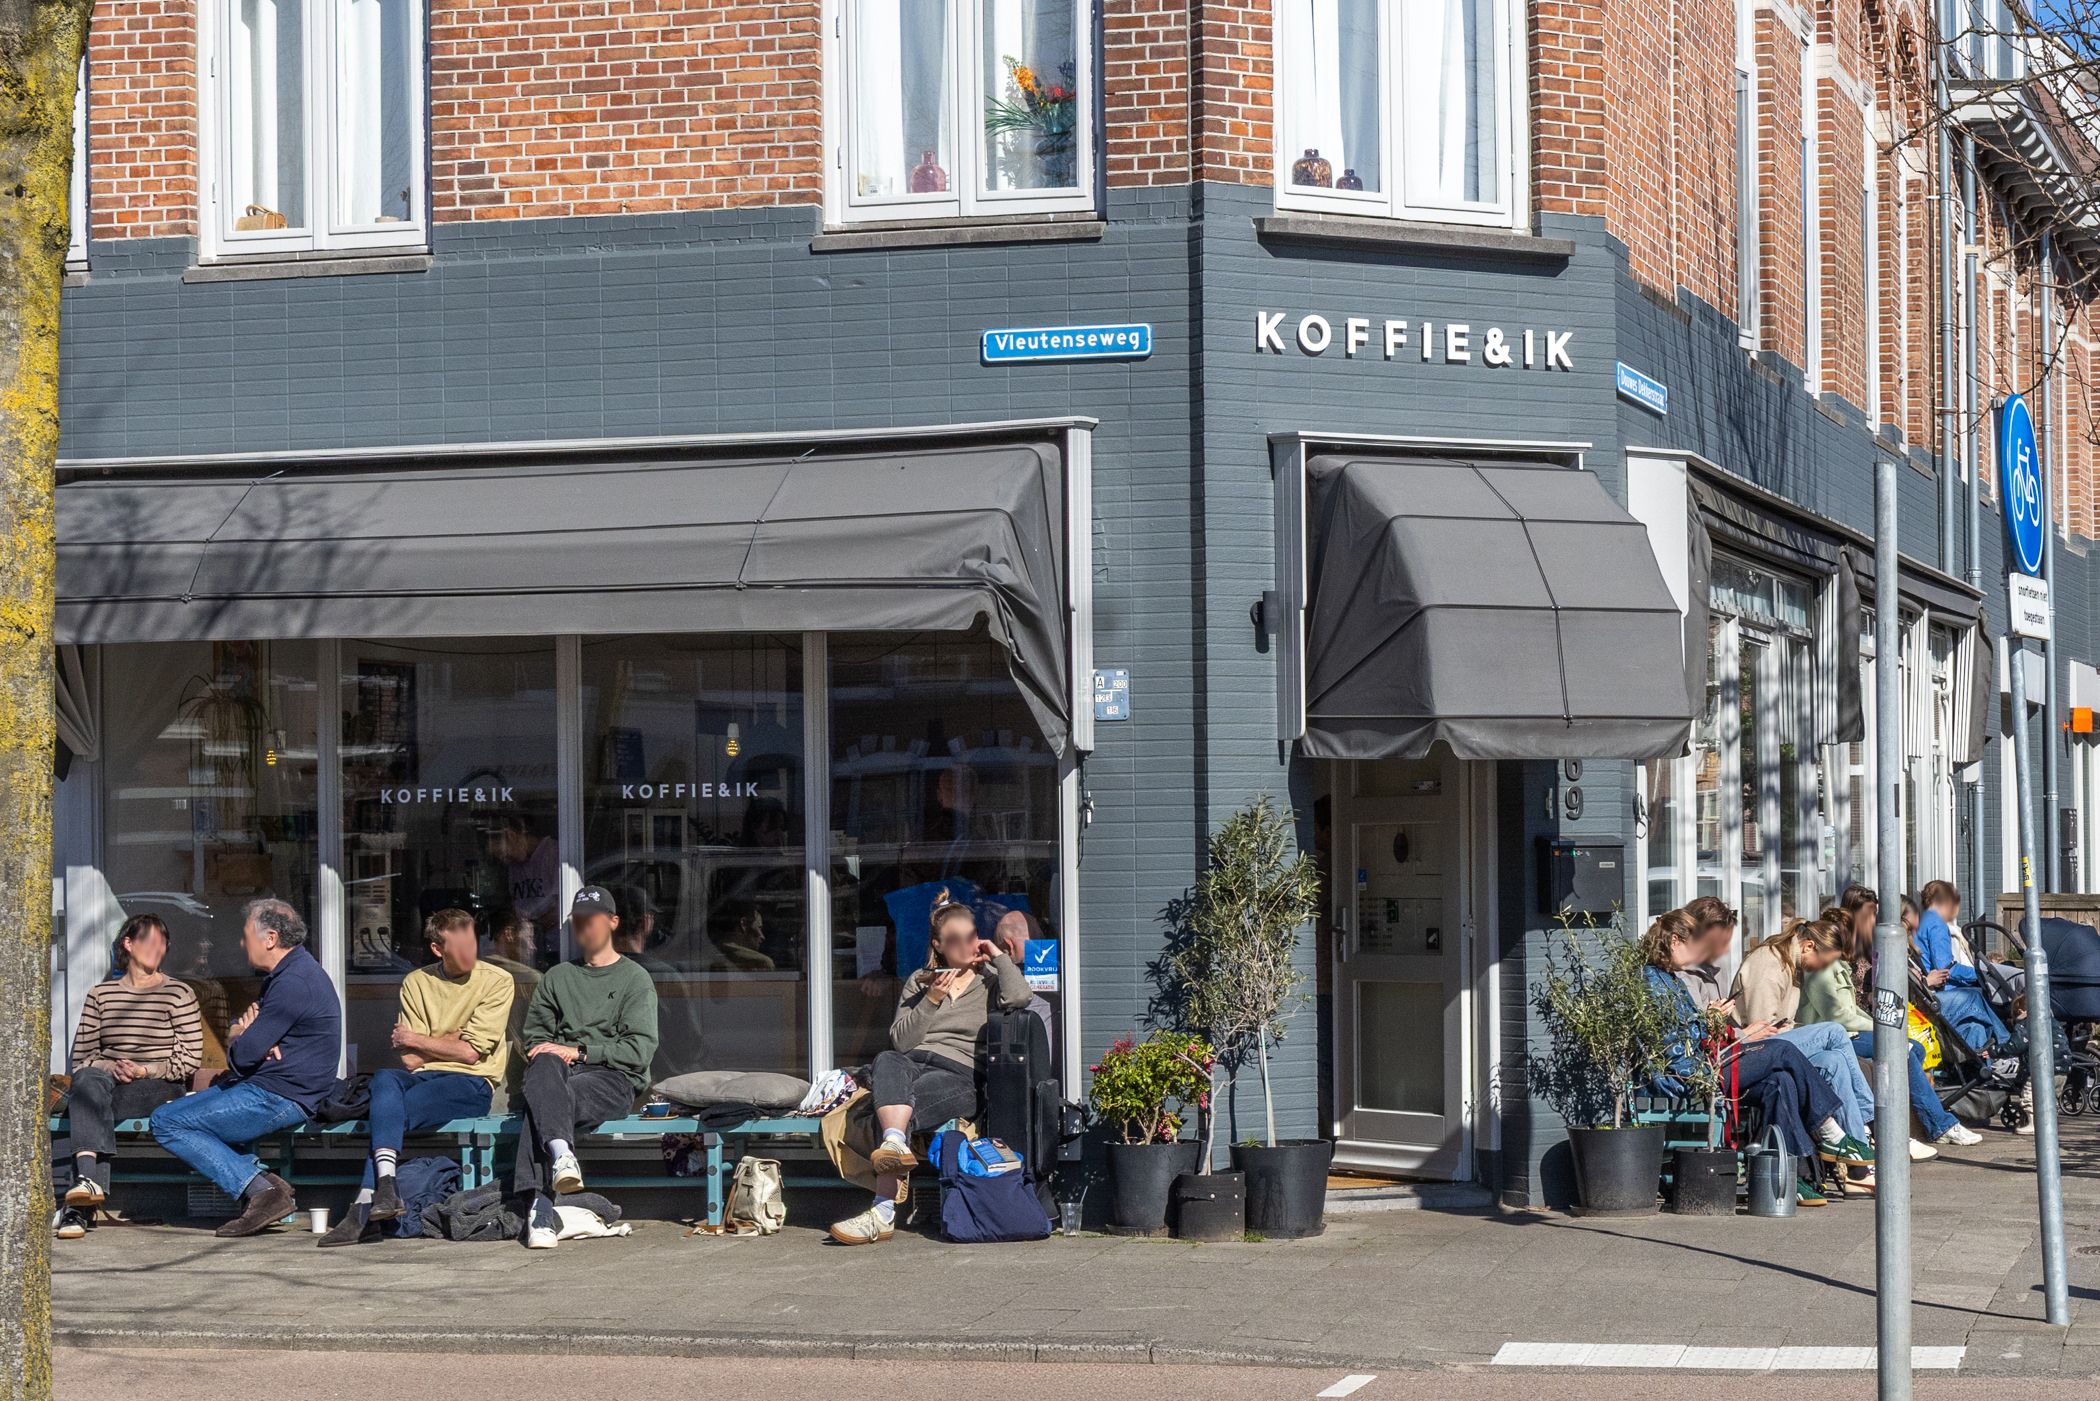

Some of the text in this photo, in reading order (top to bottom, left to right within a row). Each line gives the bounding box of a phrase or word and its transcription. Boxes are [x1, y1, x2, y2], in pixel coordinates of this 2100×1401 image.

[994, 331, 1141, 351] Vleutenseweg
[1256, 311, 1574, 369] KOFFIE&IK
[1096, 677, 1104, 688] A
[380, 787, 514, 804] KOFFIE&IK
[622, 782, 760, 800] KOFFIE&IK
